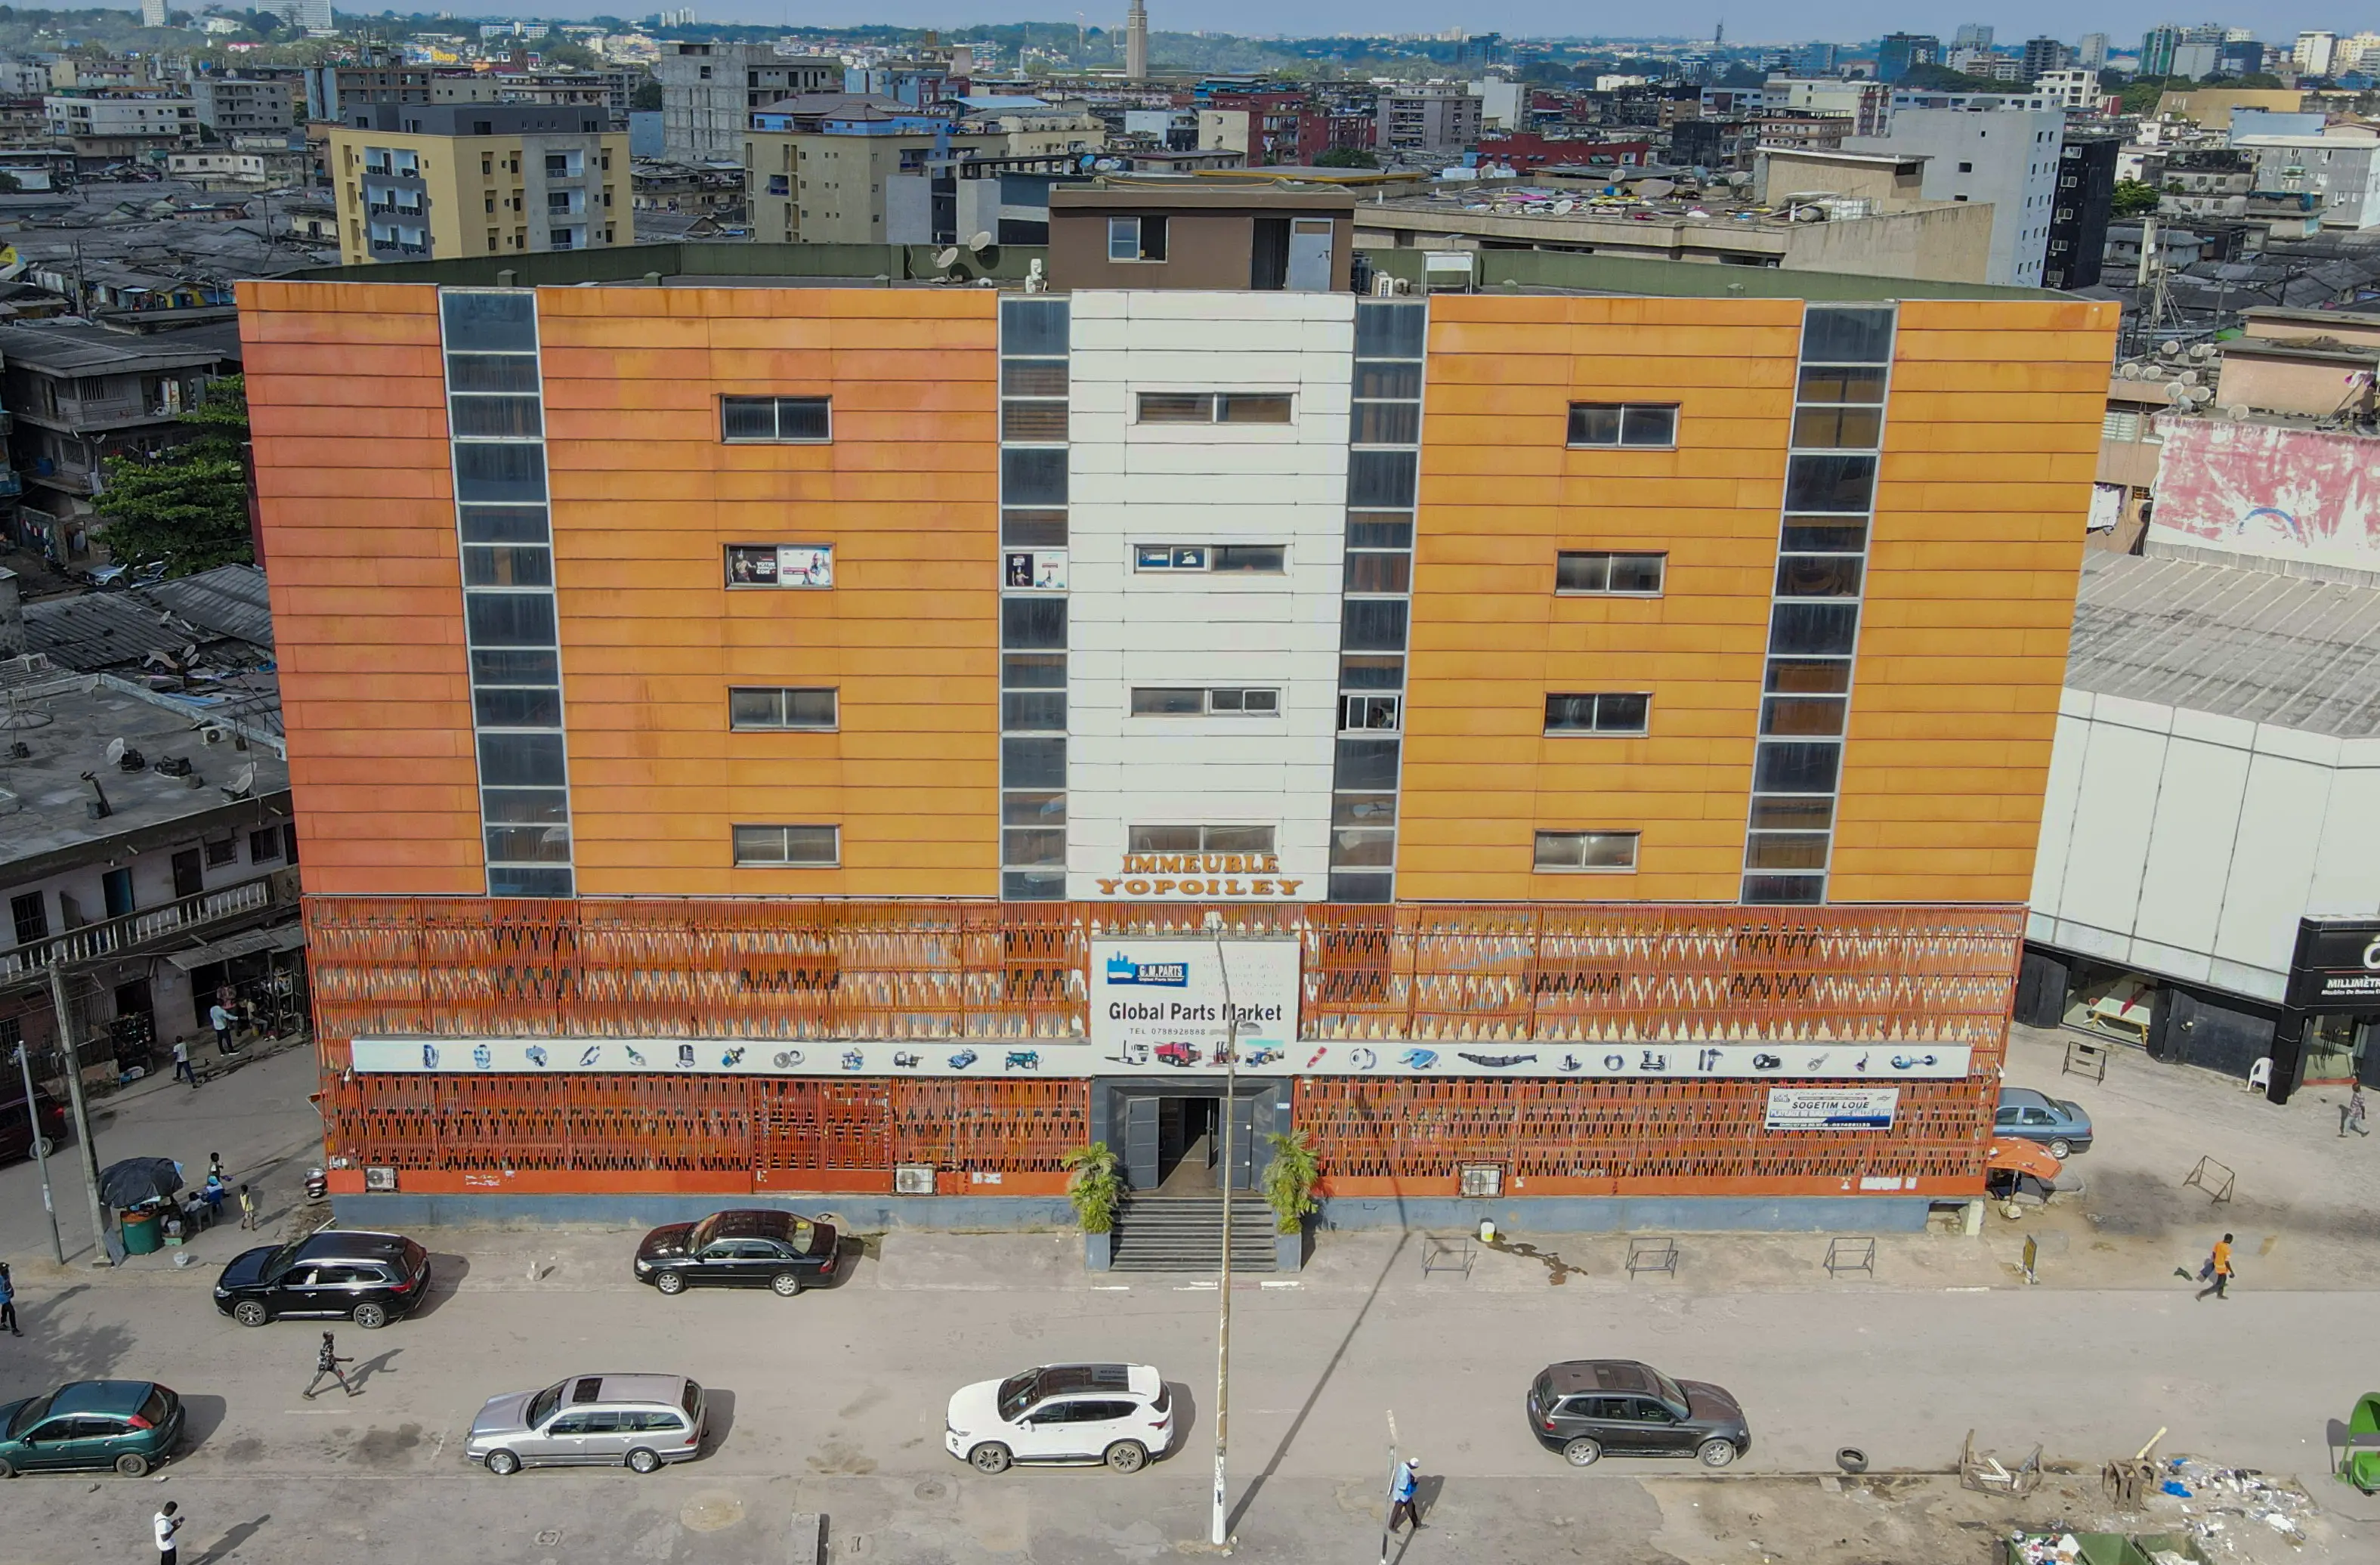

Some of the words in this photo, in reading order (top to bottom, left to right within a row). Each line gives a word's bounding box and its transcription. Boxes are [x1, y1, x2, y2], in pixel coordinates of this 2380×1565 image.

[1121, 854, 1280, 874] IMMEUBLE
[1096, 879, 1303, 895] YOPOILEY
[1109, 1002, 1164, 1020] Global
[1171, 1003, 1216, 1020] Parts
[1222, 1003, 1281, 1021] Market
[1791, 1101, 1839, 1109] SOGETIM
[1841, 1101, 1870, 1109] LOUE
